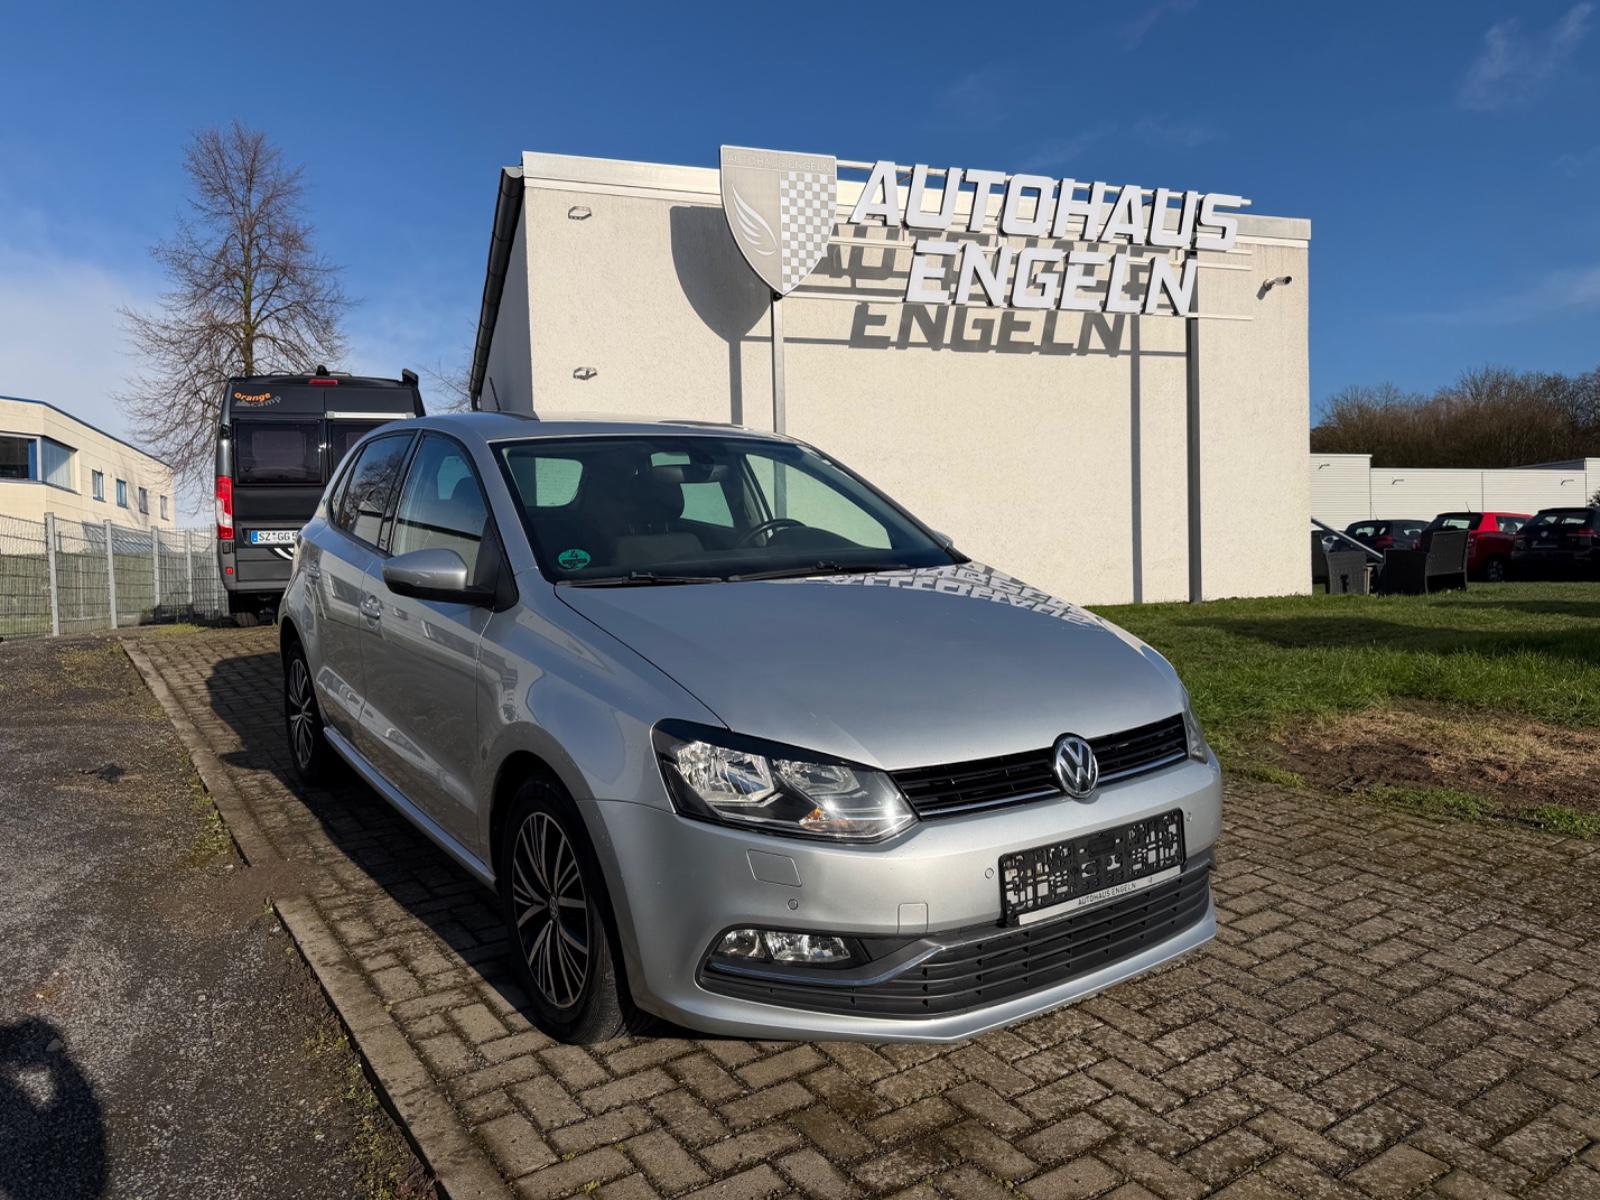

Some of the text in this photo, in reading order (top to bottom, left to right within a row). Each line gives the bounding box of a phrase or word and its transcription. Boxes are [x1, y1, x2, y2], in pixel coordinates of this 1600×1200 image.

[849, 160, 1242, 251] AUTOHAUS
[906, 239, 1198, 317] ENGELN
[258, 532, 271, 541] SZ
[1078, 881, 1136, 905] AUTOHAUS ENGELN
